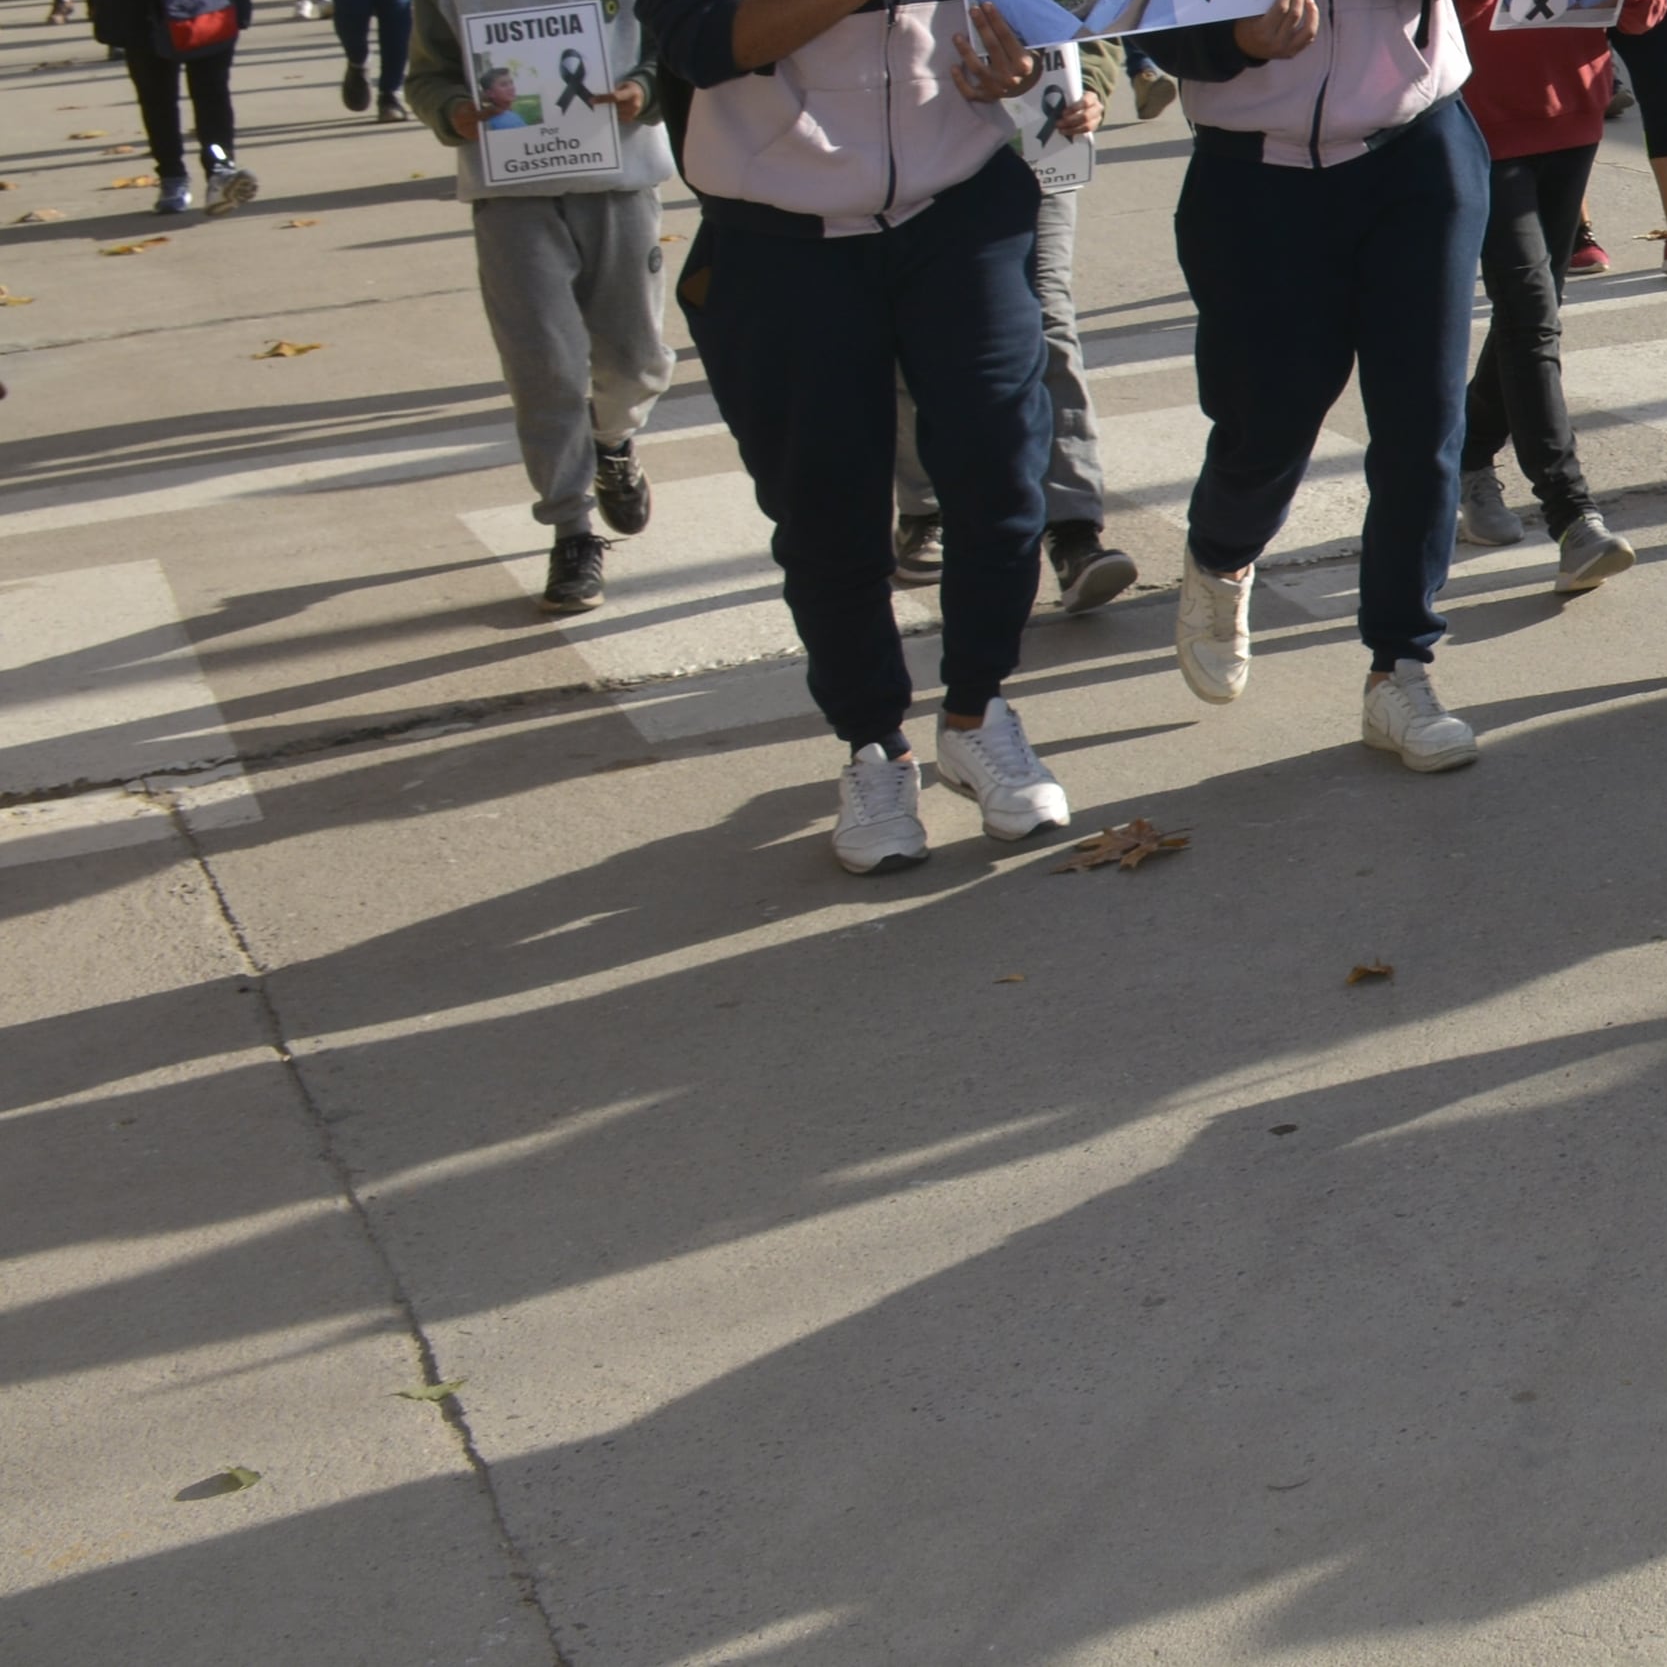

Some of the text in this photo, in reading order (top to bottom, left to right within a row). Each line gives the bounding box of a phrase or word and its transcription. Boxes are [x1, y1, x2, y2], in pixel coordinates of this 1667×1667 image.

[485, 14, 584, 45] JUSTICIA
[540, 127, 559, 137] Por
[524, 137, 581, 156] Lucho
[504, 151, 604, 173] Gassmann
